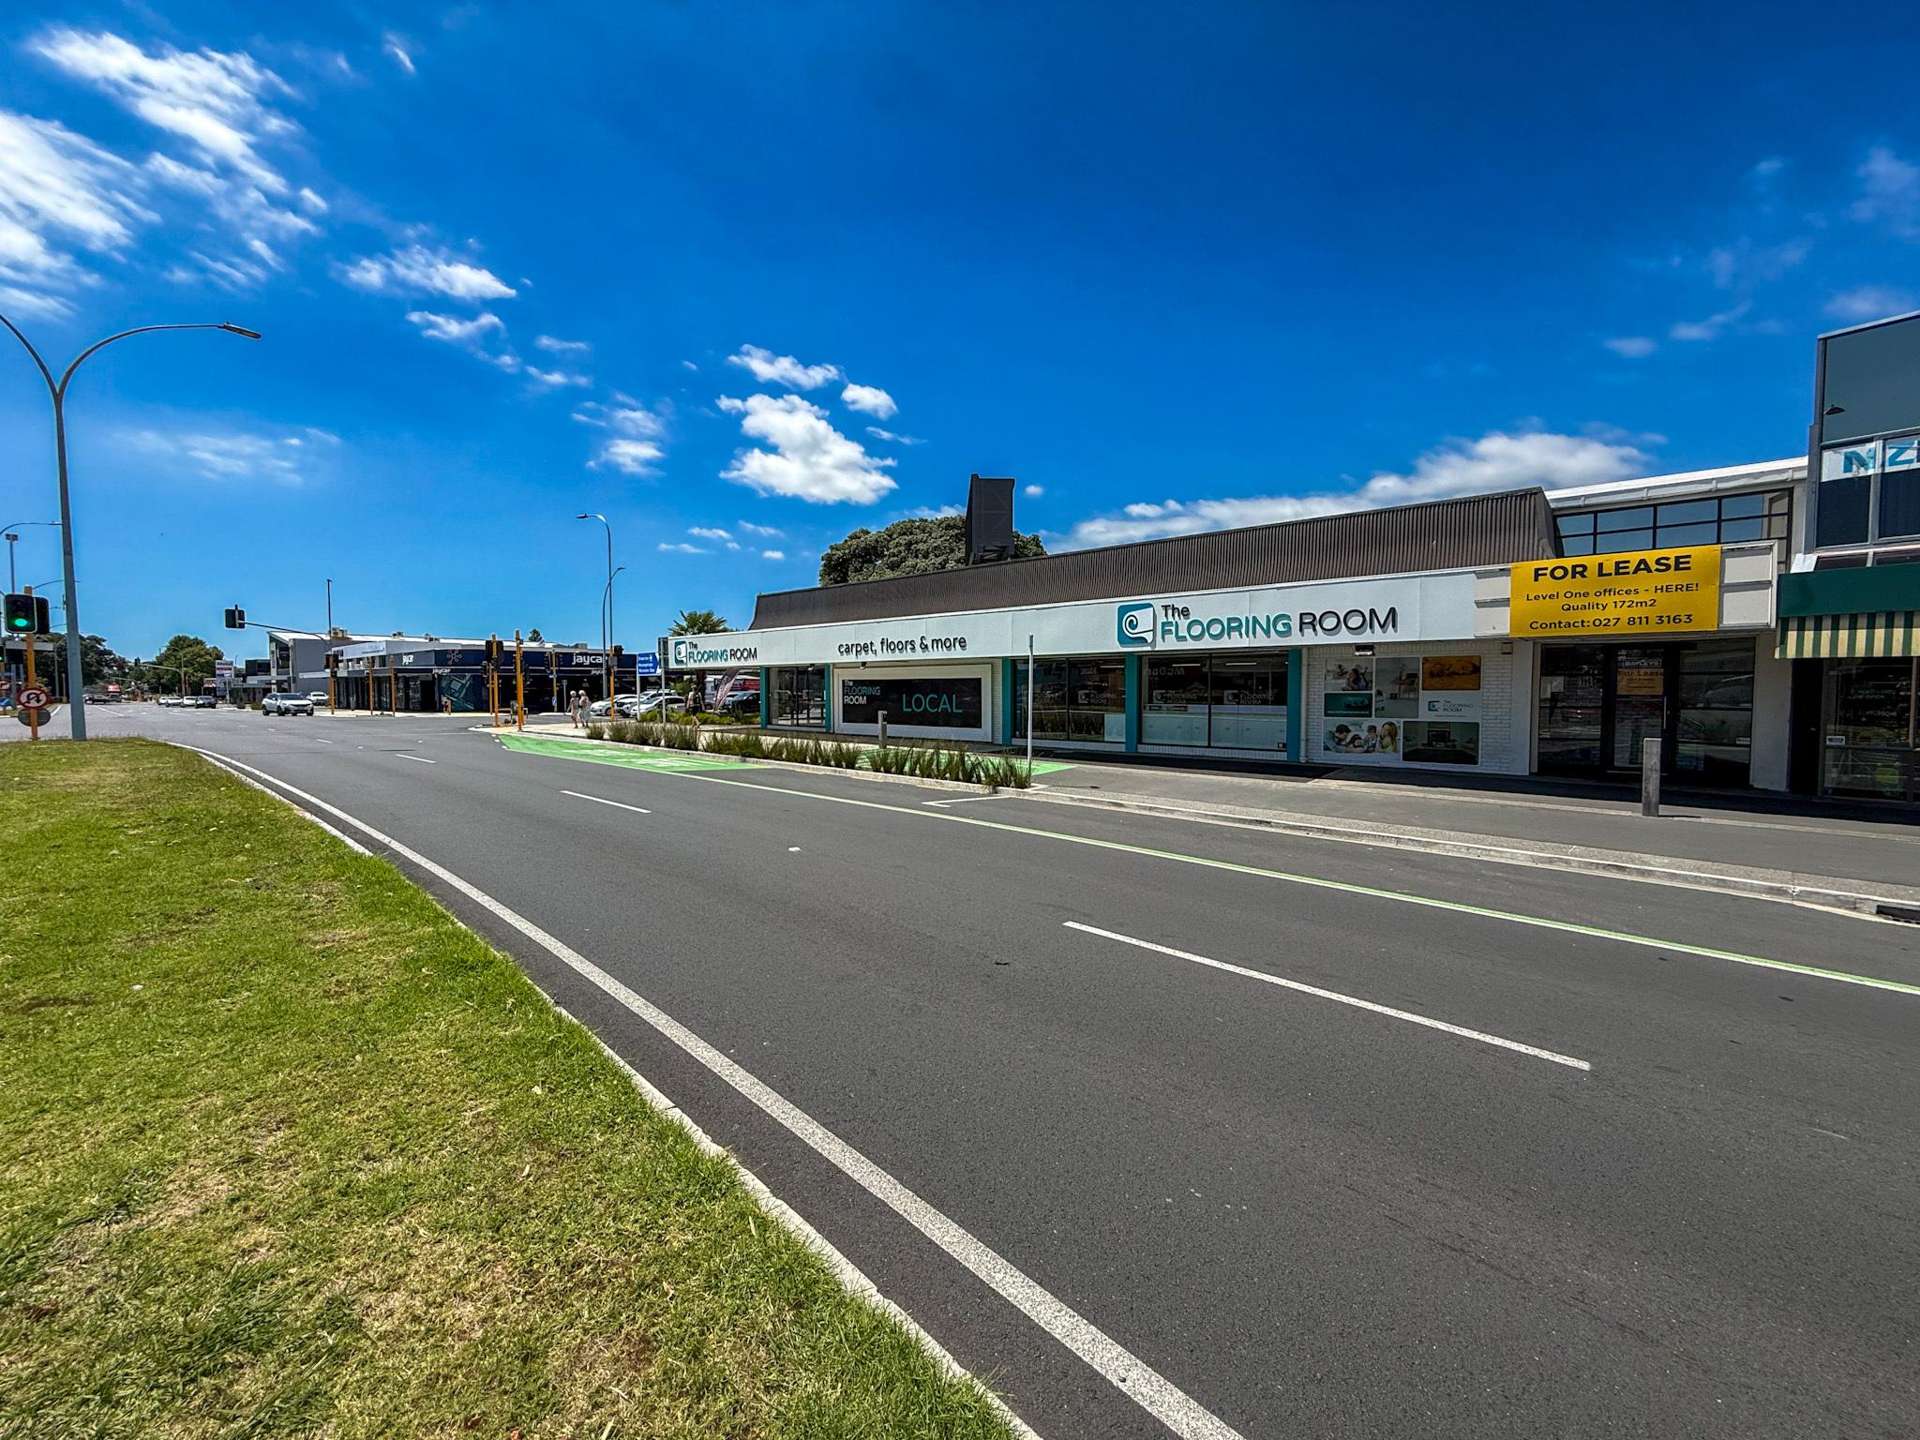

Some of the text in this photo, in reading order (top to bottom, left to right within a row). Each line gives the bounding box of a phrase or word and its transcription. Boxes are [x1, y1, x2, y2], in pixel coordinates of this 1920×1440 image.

[1843, 440, 1920, 474] NZ
[1533, 554, 1692, 582] FOR LEASE
[1526, 591, 1560, 601] Level
[1563, 590, 1590, 599] One
[1594, 586, 1640, 597] offices
[1654, 583, 1699, 594] HERE!
[1161, 604, 1190, 618] The
[1561, 598, 1657, 613] Quality 172m2
[1160, 606, 1398, 641] FLOORING ROOM
[1627, 615, 1650, 626] 811
[1655, 614, 1693, 625] 3163
[688, 641, 698, 650] The
[838, 635, 967, 658] carpet, floors & more
[571, 653, 608, 665] jayca
[688, 647, 758, 663] FLOORING ROOM
[844, 686, 881, 696] FLOORING
[844, 695, 867, 705] ROOM
[902, 693, 964, 713] LOCAL
